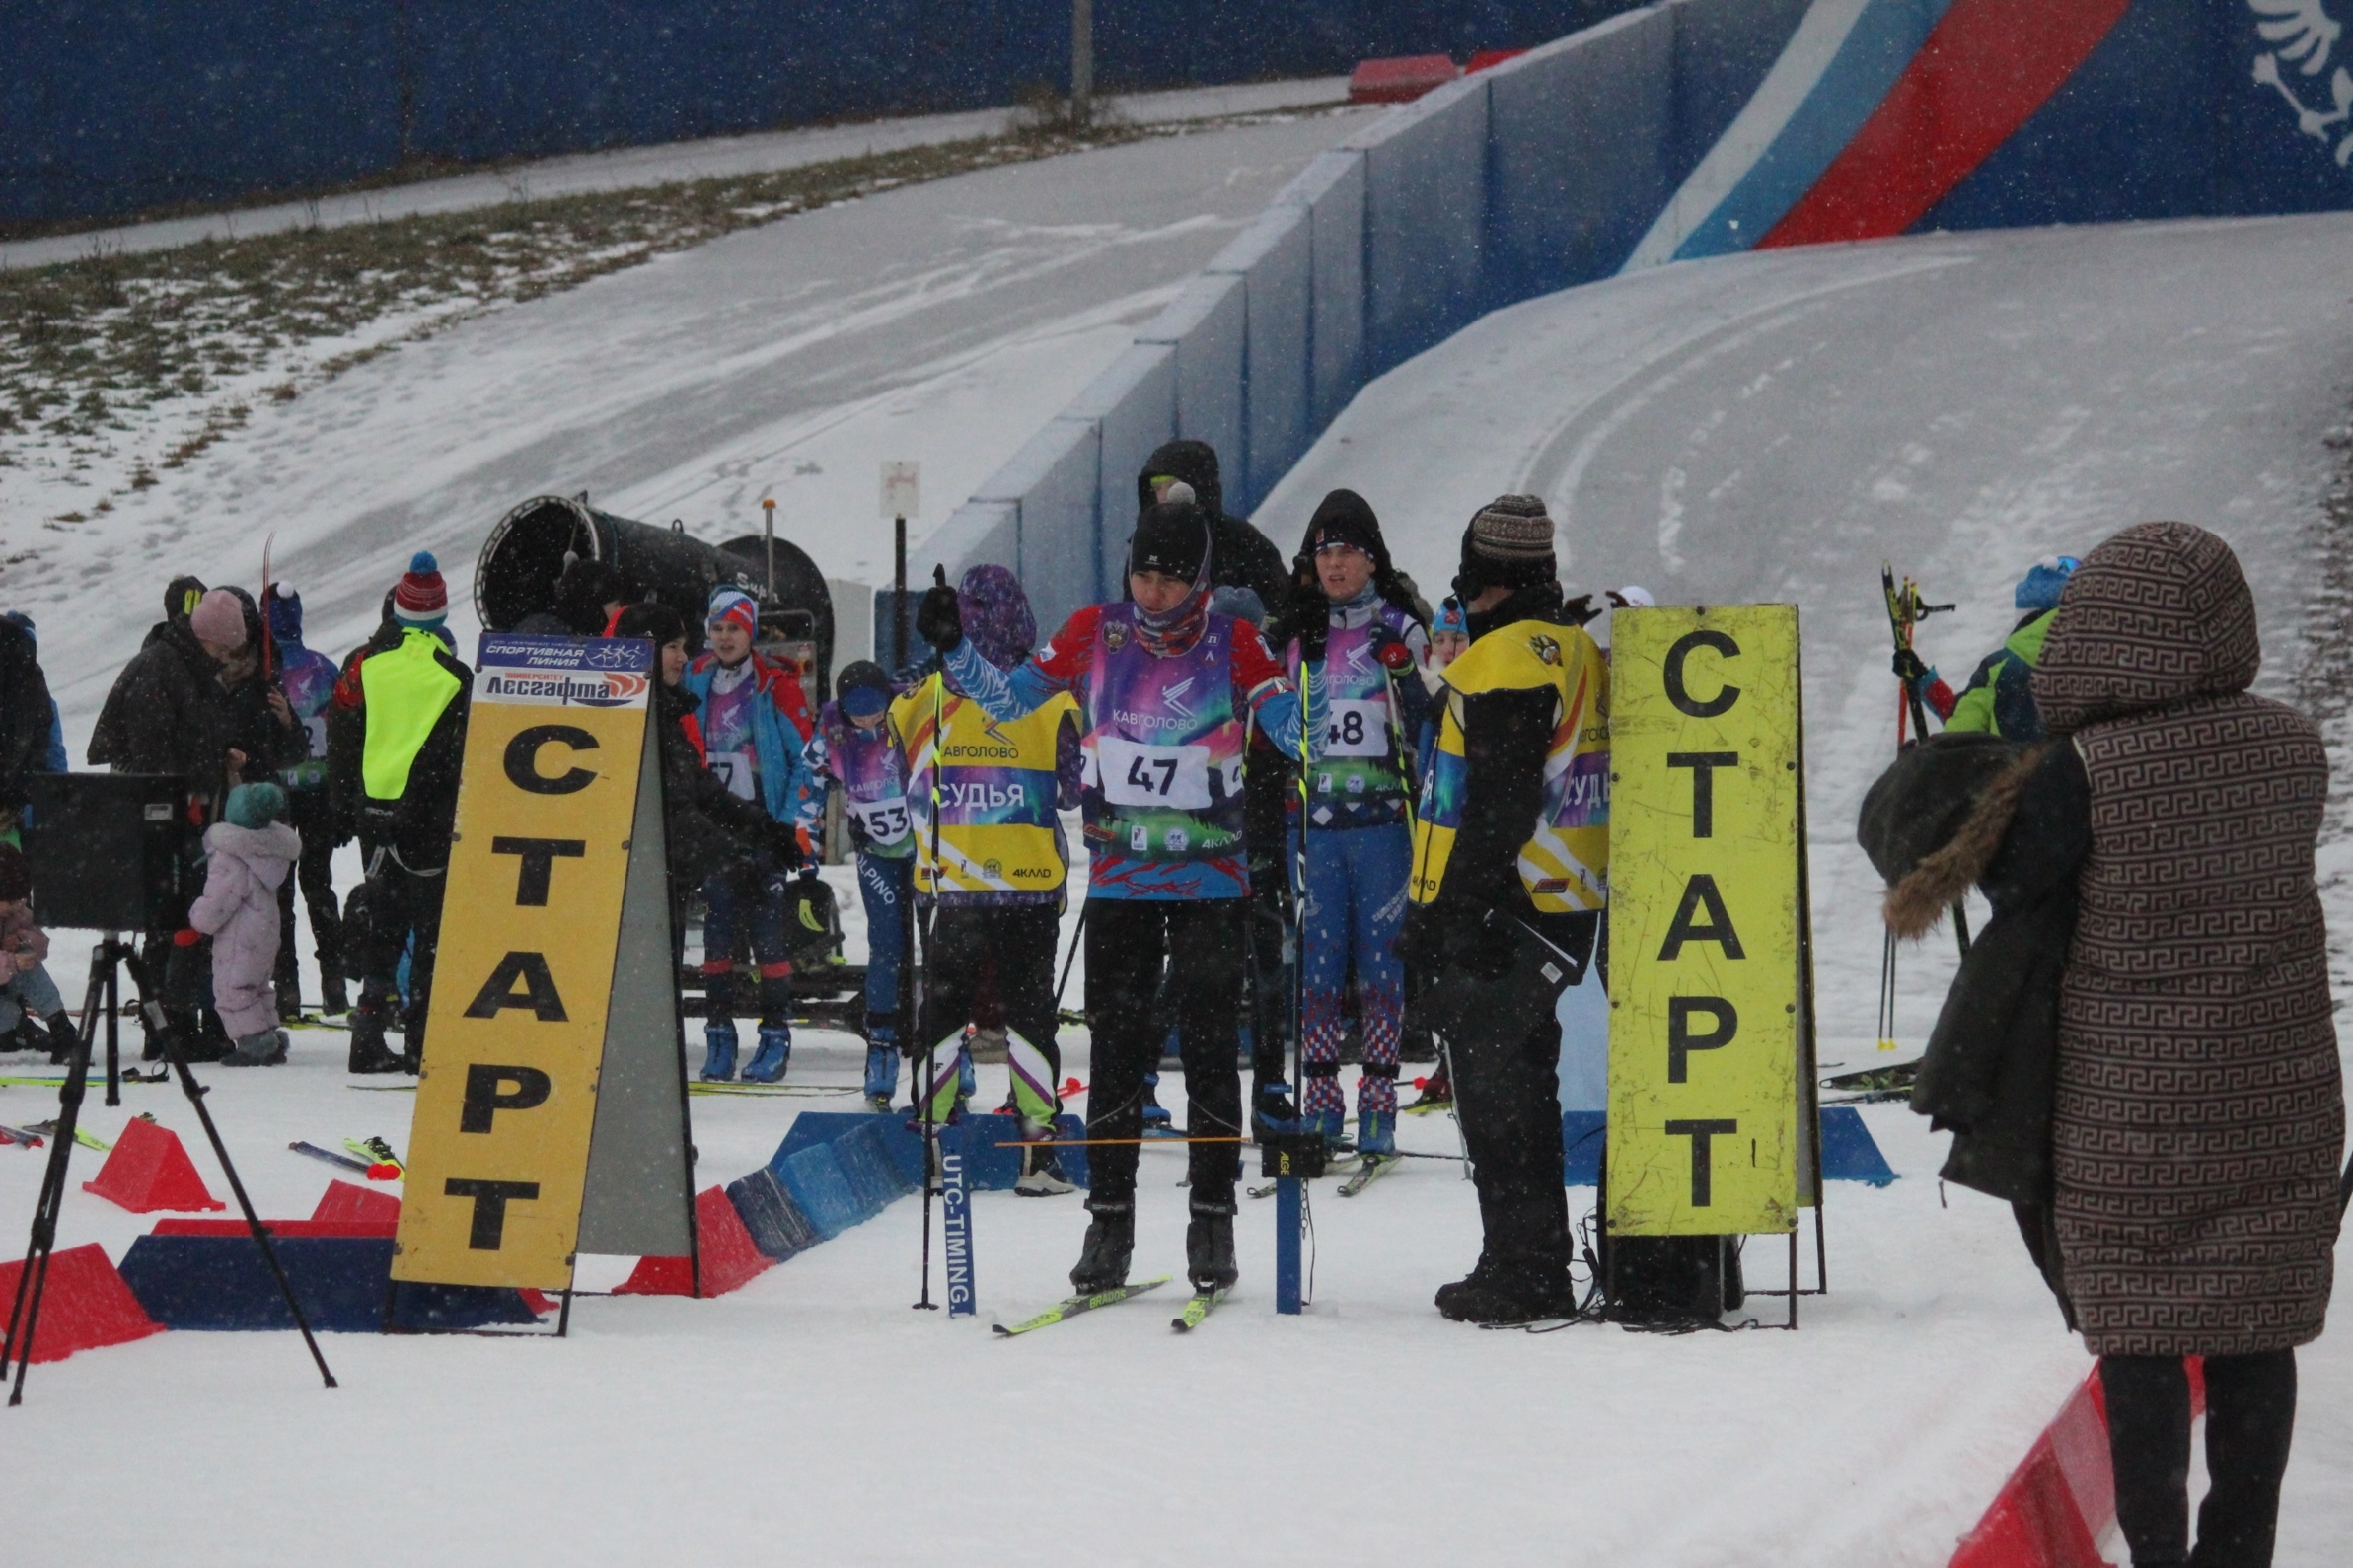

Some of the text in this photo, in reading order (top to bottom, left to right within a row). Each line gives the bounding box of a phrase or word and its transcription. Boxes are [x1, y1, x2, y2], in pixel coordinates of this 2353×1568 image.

[485, 645, 585, 657] СПОРТИВНАЯ
[527, 656, 580, 667] ЛИНИЯ
[505, 672, 563, 681] УНИВЕРСИТЕТ
[1113, 710, 1198, 731] КАВГОЛОВО
[940, 745, 1019, 758] АВГОЛОВО
[1127, 756, 1177, 796] 47
[939, 783, 1024, 812] СУДЬЯ
[869, 806, 907, 837] 53
[1656, 630, 1745, 1208] СТАРТ
[444, 724, 601, 1251] СТАРТ
[1280, 1151, 1290, 1176] ALGE
[1192, 1203, 1226, 1212] SPINE
[942, 1155, 971, 1318] UTC-TIMING.
